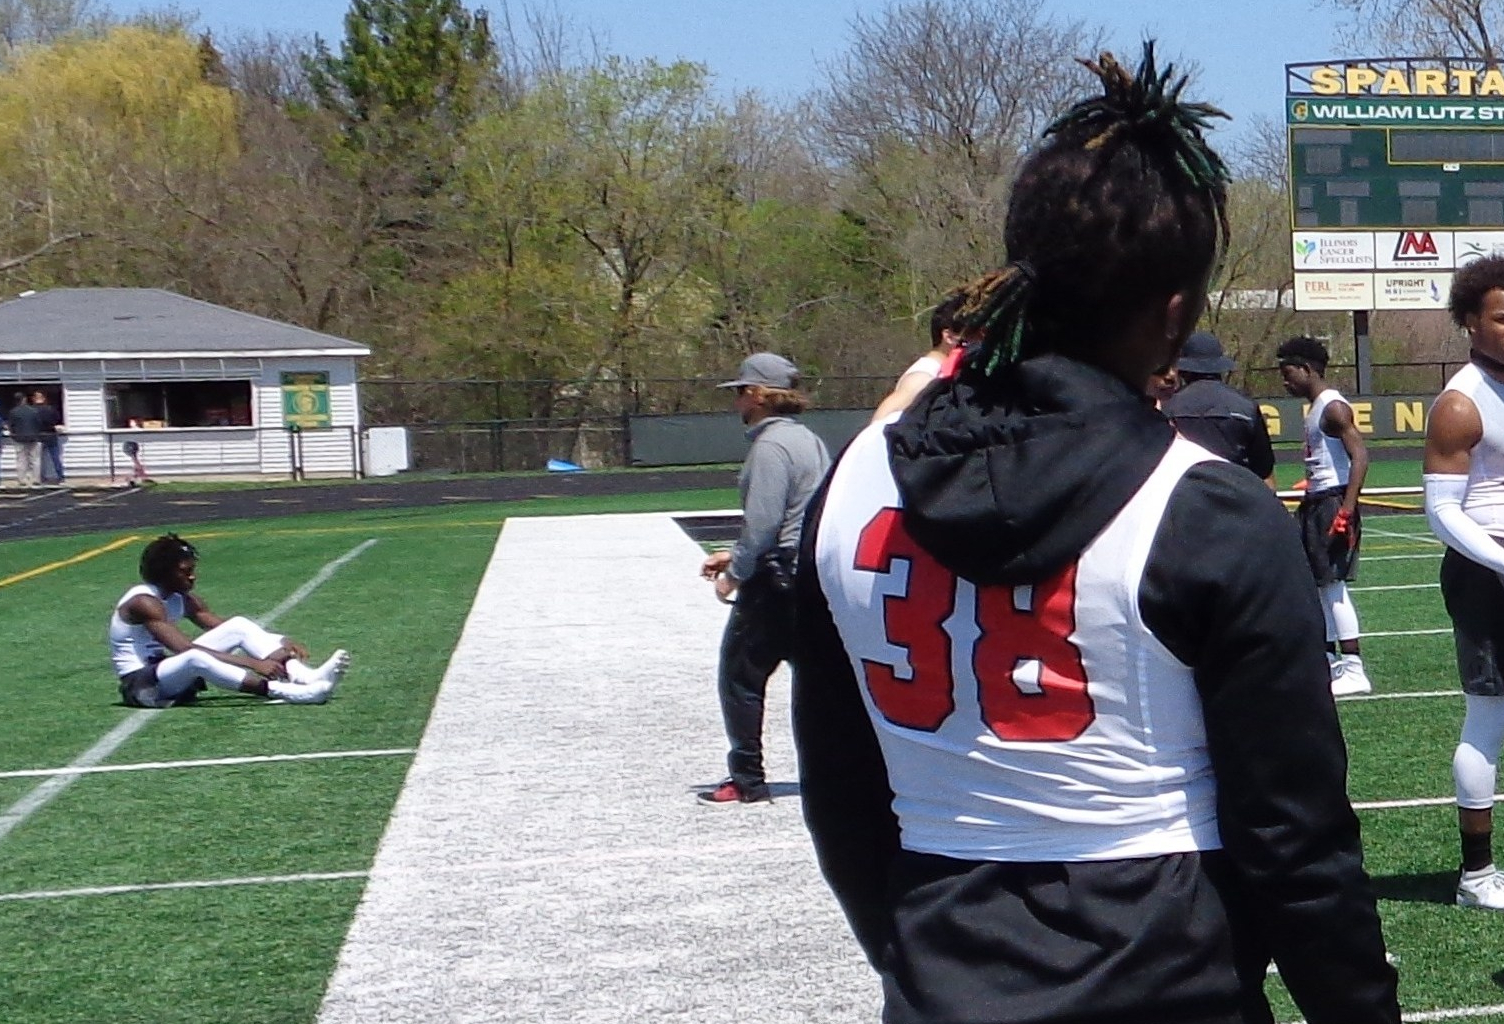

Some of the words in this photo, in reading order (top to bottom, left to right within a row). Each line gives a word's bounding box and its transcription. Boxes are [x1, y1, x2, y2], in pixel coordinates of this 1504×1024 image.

[1312, 104, 1413, 120] WILLIAM
[1416, 105, 1476, 120] LUTZ
[853, 506, 1096, 742] 38
